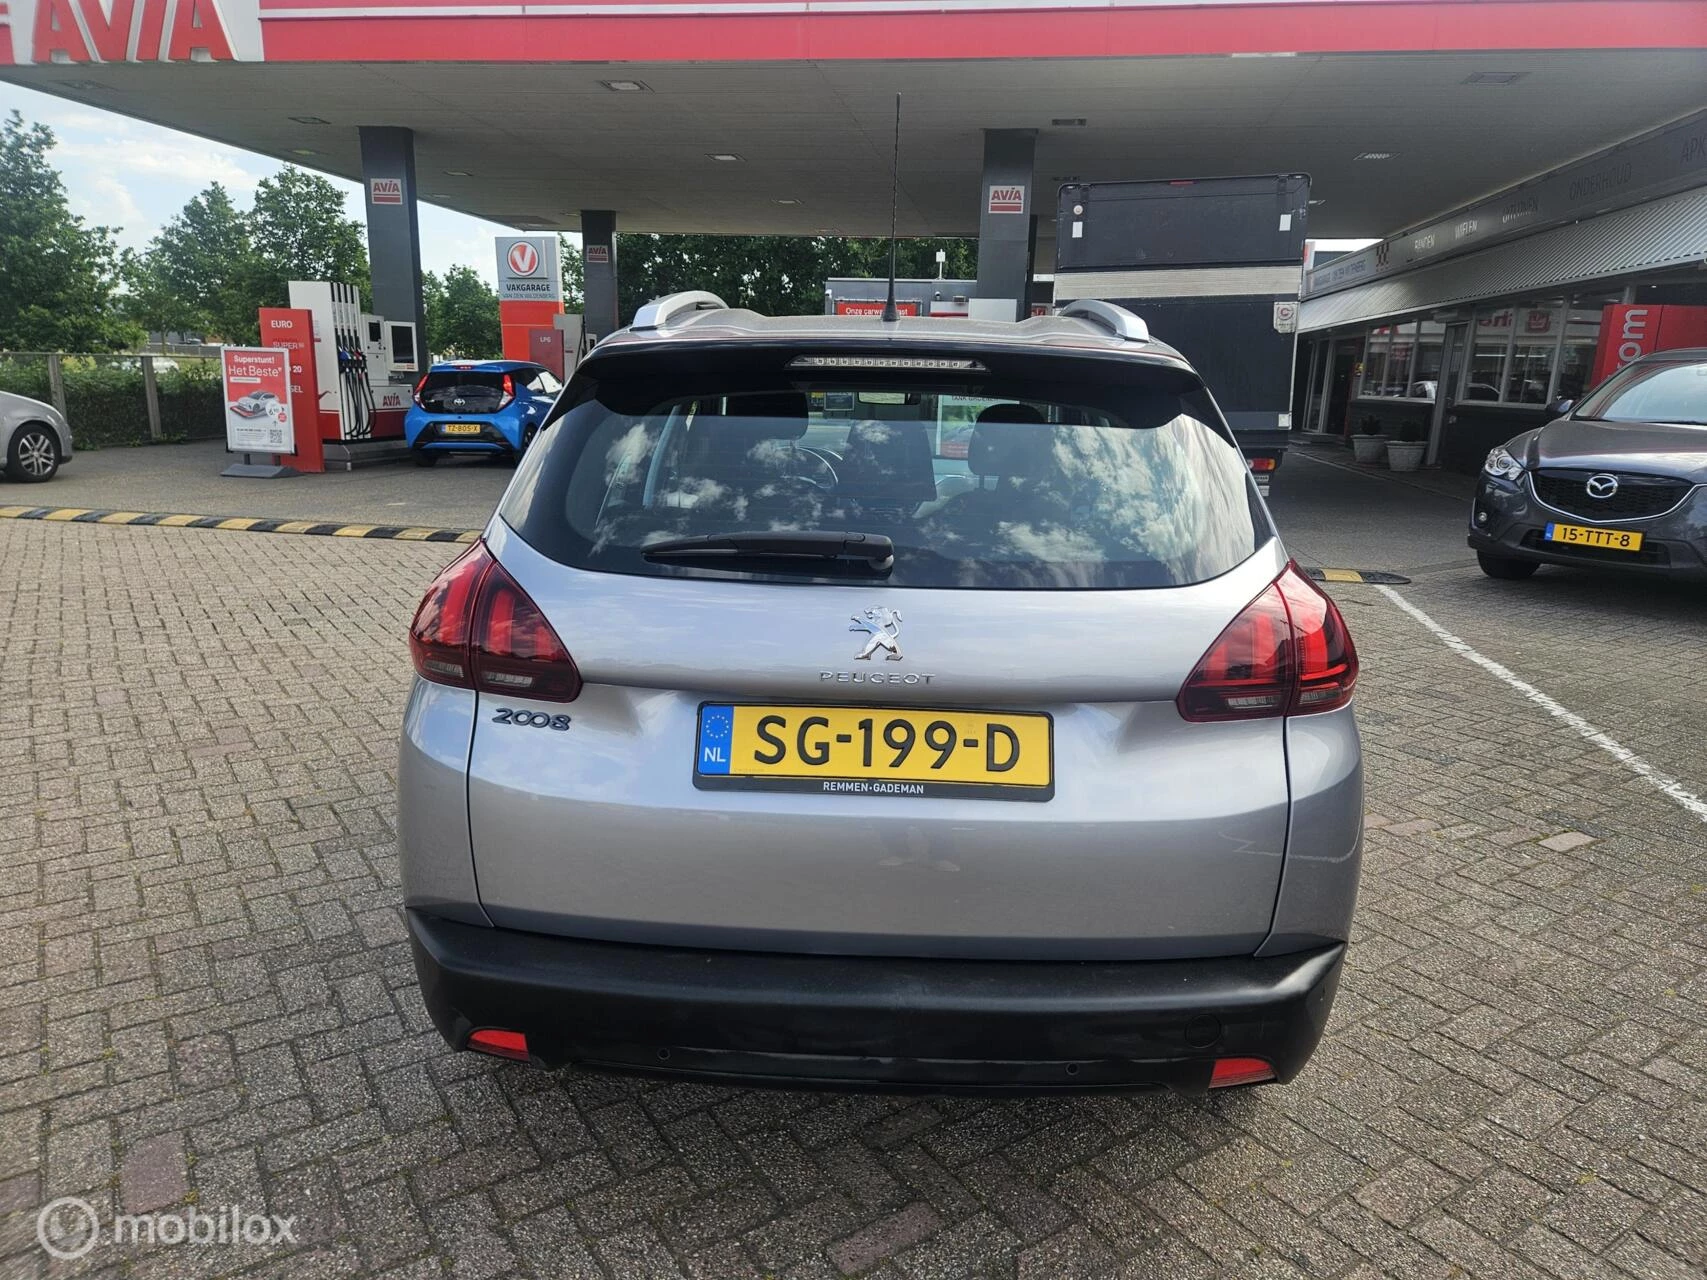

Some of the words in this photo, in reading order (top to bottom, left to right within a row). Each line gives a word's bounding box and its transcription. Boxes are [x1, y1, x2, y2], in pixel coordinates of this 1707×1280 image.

[32, 0, 234, 61] AVIA
[373, 180, 400, 192] AVIA
[990, 187, 1022, 200] AVIA
[588, 246, 607, 255] AVIA
[845, 307, 862, 315] Onze
[271, 320, 293, 328] EURO
[233, 355, 275, 364] Superstunt!
[228, 365, 247, 375] Het
[249, 366, 279, 376] Beste
[383, 393, 401, 407] AVIA
[1562, 527, 1631, 547] 15-TTT-8
[819, 670, 936, 685] PEUGEOT
[491, 708, 572, 732] 2008
[703, 746, 727, 763] NL
[754, 715, 1021, 772] SG-199-D
